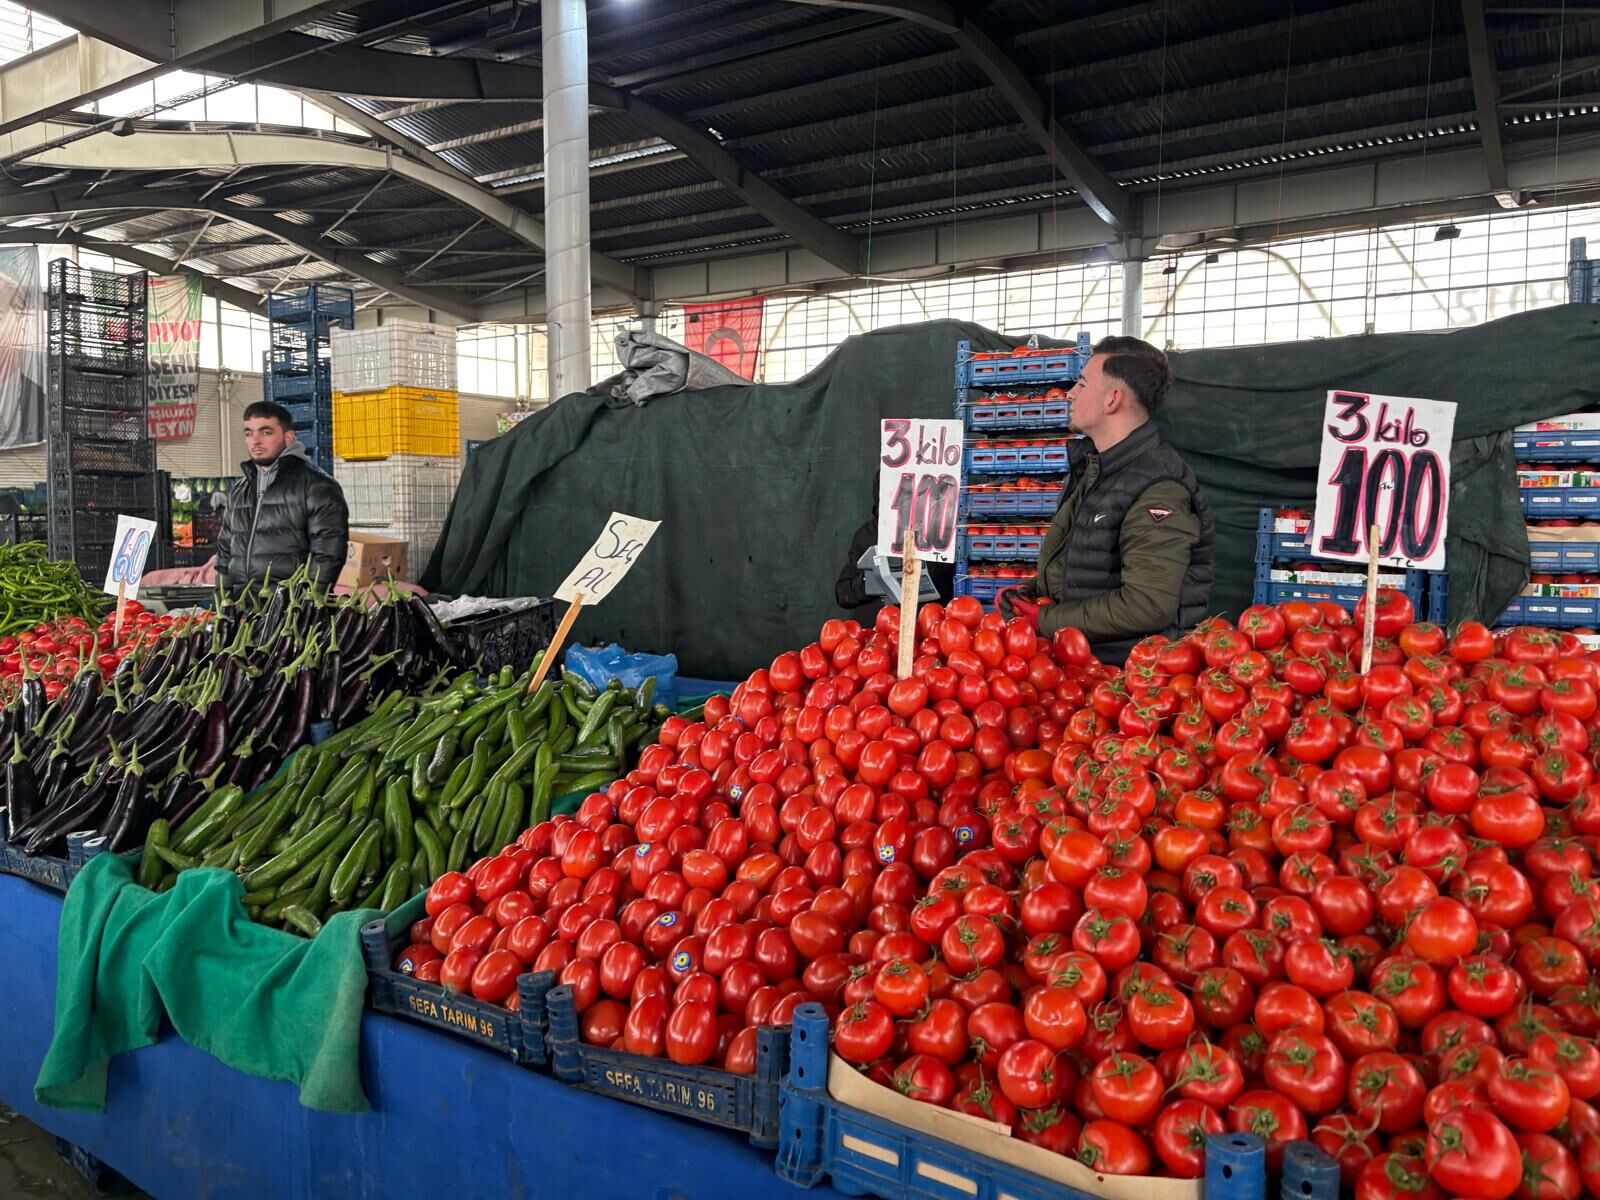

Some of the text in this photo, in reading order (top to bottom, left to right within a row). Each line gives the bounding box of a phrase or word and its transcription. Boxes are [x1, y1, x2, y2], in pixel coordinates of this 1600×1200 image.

[882, 420, 960, 468] 3 kilo
[1328, 388, 1430, 447] 3 kilo
[891, 473, 959, 554] 100
[1319, 446, 1446, 561] 100
[113, 528, 150, 585] 60
[408, 995, 494, 1038] SEFA TARIM 96
[606, 1071, 643, 1095] SEFA
[697, 1091, 715, 1111] 96
